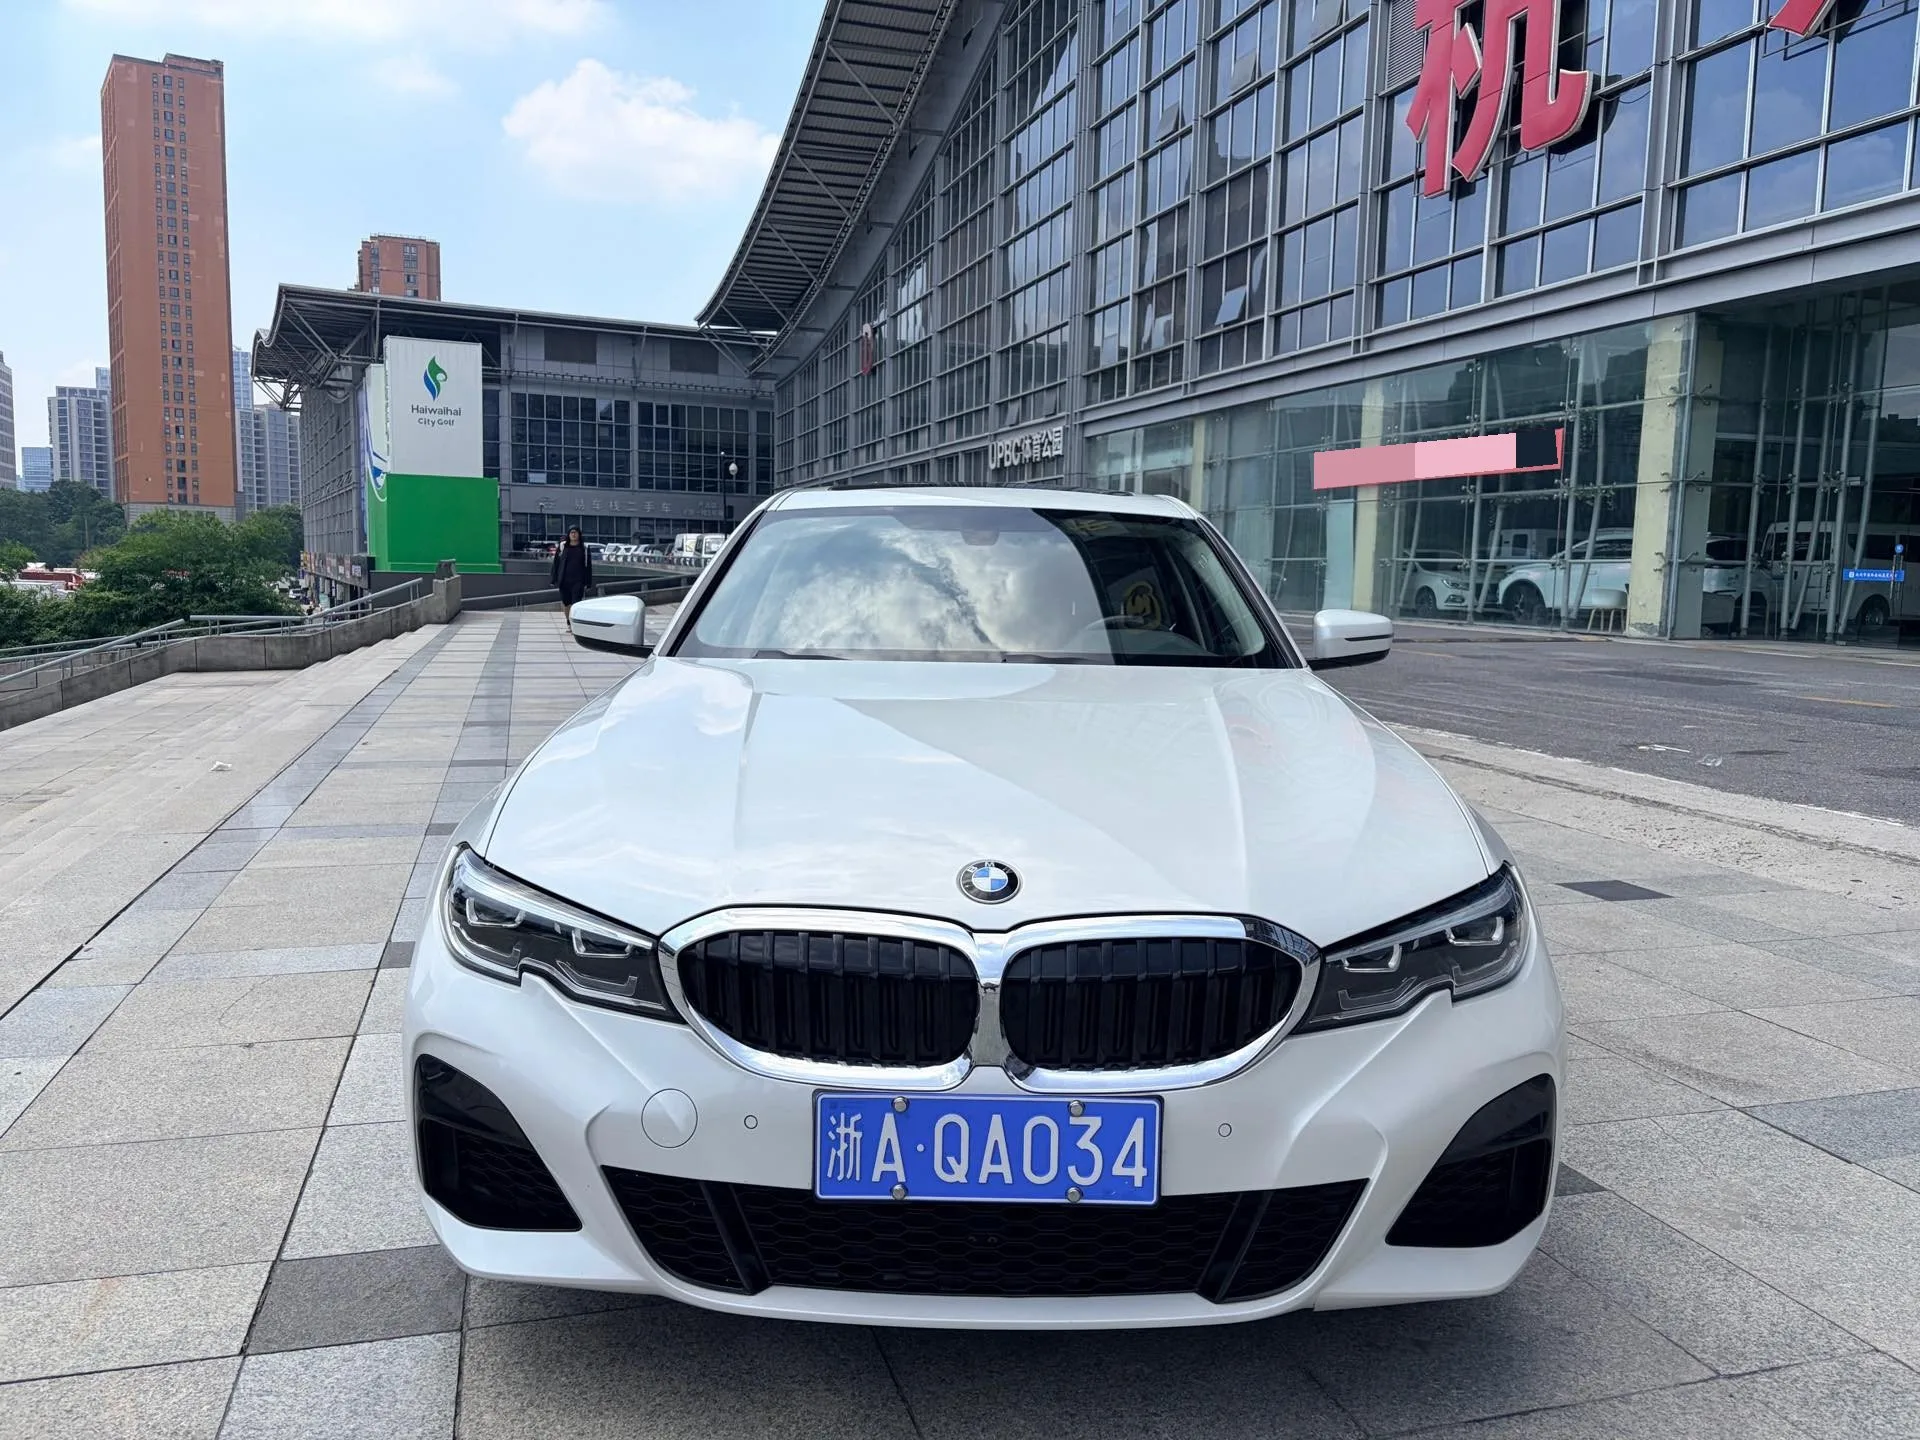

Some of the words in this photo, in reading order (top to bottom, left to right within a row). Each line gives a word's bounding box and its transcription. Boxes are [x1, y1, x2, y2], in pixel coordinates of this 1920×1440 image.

[1405, 0, 1593, 199] 机
[411, 404, 462, 416] Haiwaihai
[417, 417, 436, 427] City
[437, 418, 455, 427] Golf
